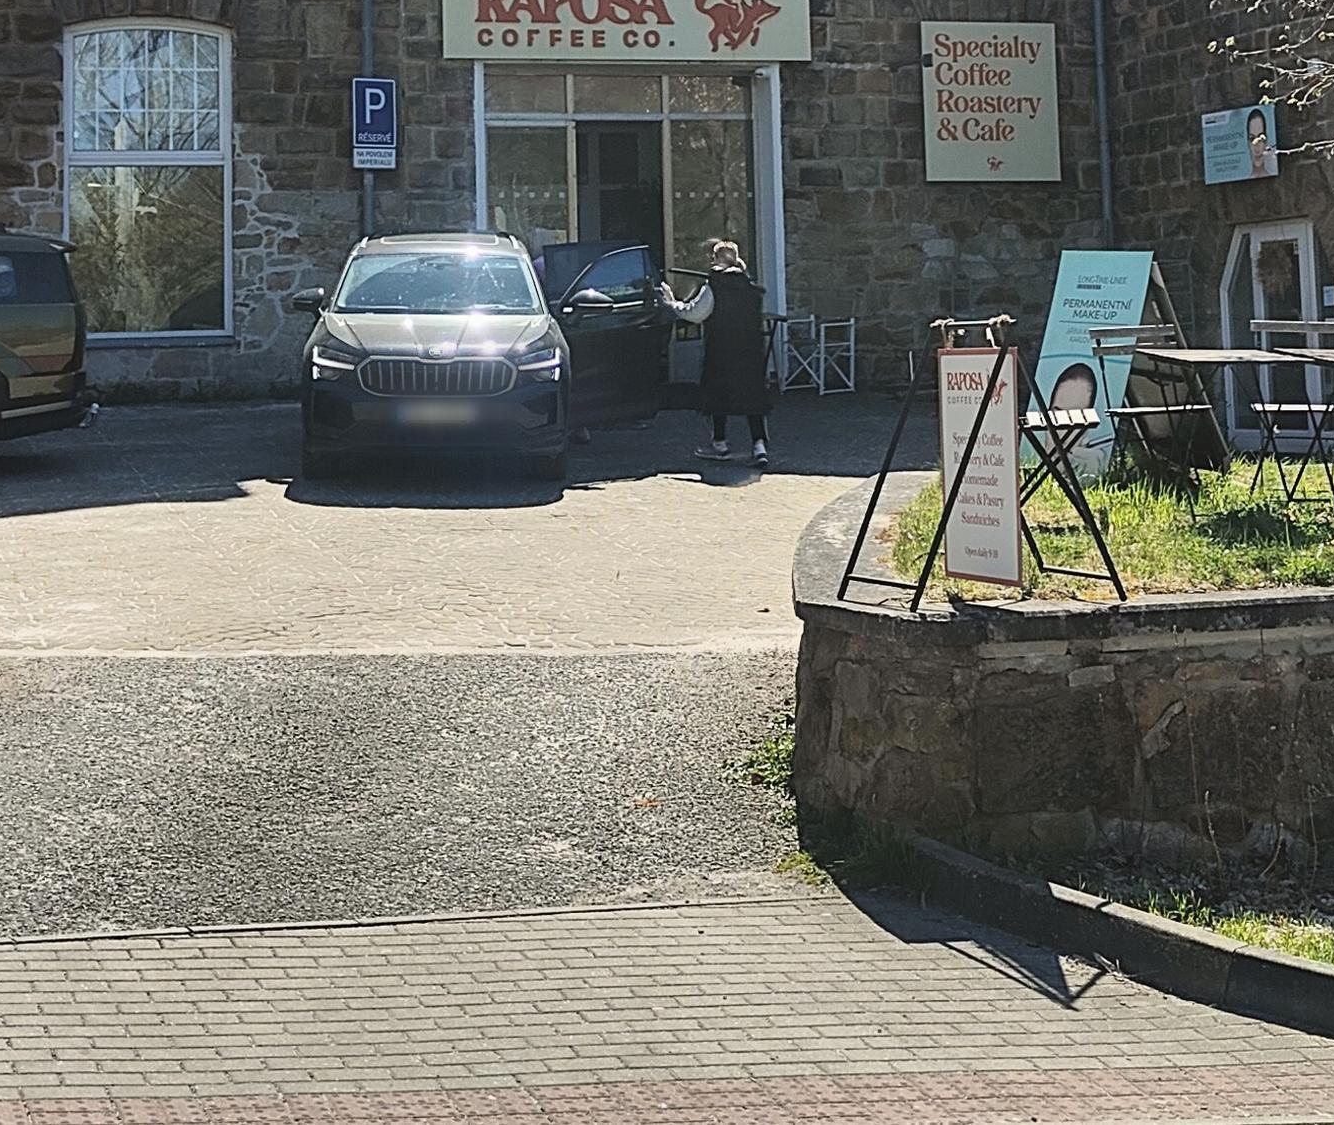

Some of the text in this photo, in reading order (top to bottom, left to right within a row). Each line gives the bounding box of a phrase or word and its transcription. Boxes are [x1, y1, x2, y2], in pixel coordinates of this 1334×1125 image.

[477, 28, 676, 48] COFFEE CO.
[934, 33, 1042, 64] Specialty
[935, 62, 1011, 86] Coffee
[365, 88, 386, 124] P
[936, 89, 1042, 119] Roastery
[936, 117, 1015, 141] & Cafe
[1063, 298, 1133, 311] PERMANENTNÍ
[1072, 310, 1118, 321] MAKE-UP
[947, 372, 985, 391] RAPOSA
[947, 396, 972, 405] COFFEE
[982, 433, 1004, 447] Coffee
[961, 511, 1001, 527] Sandwiches
